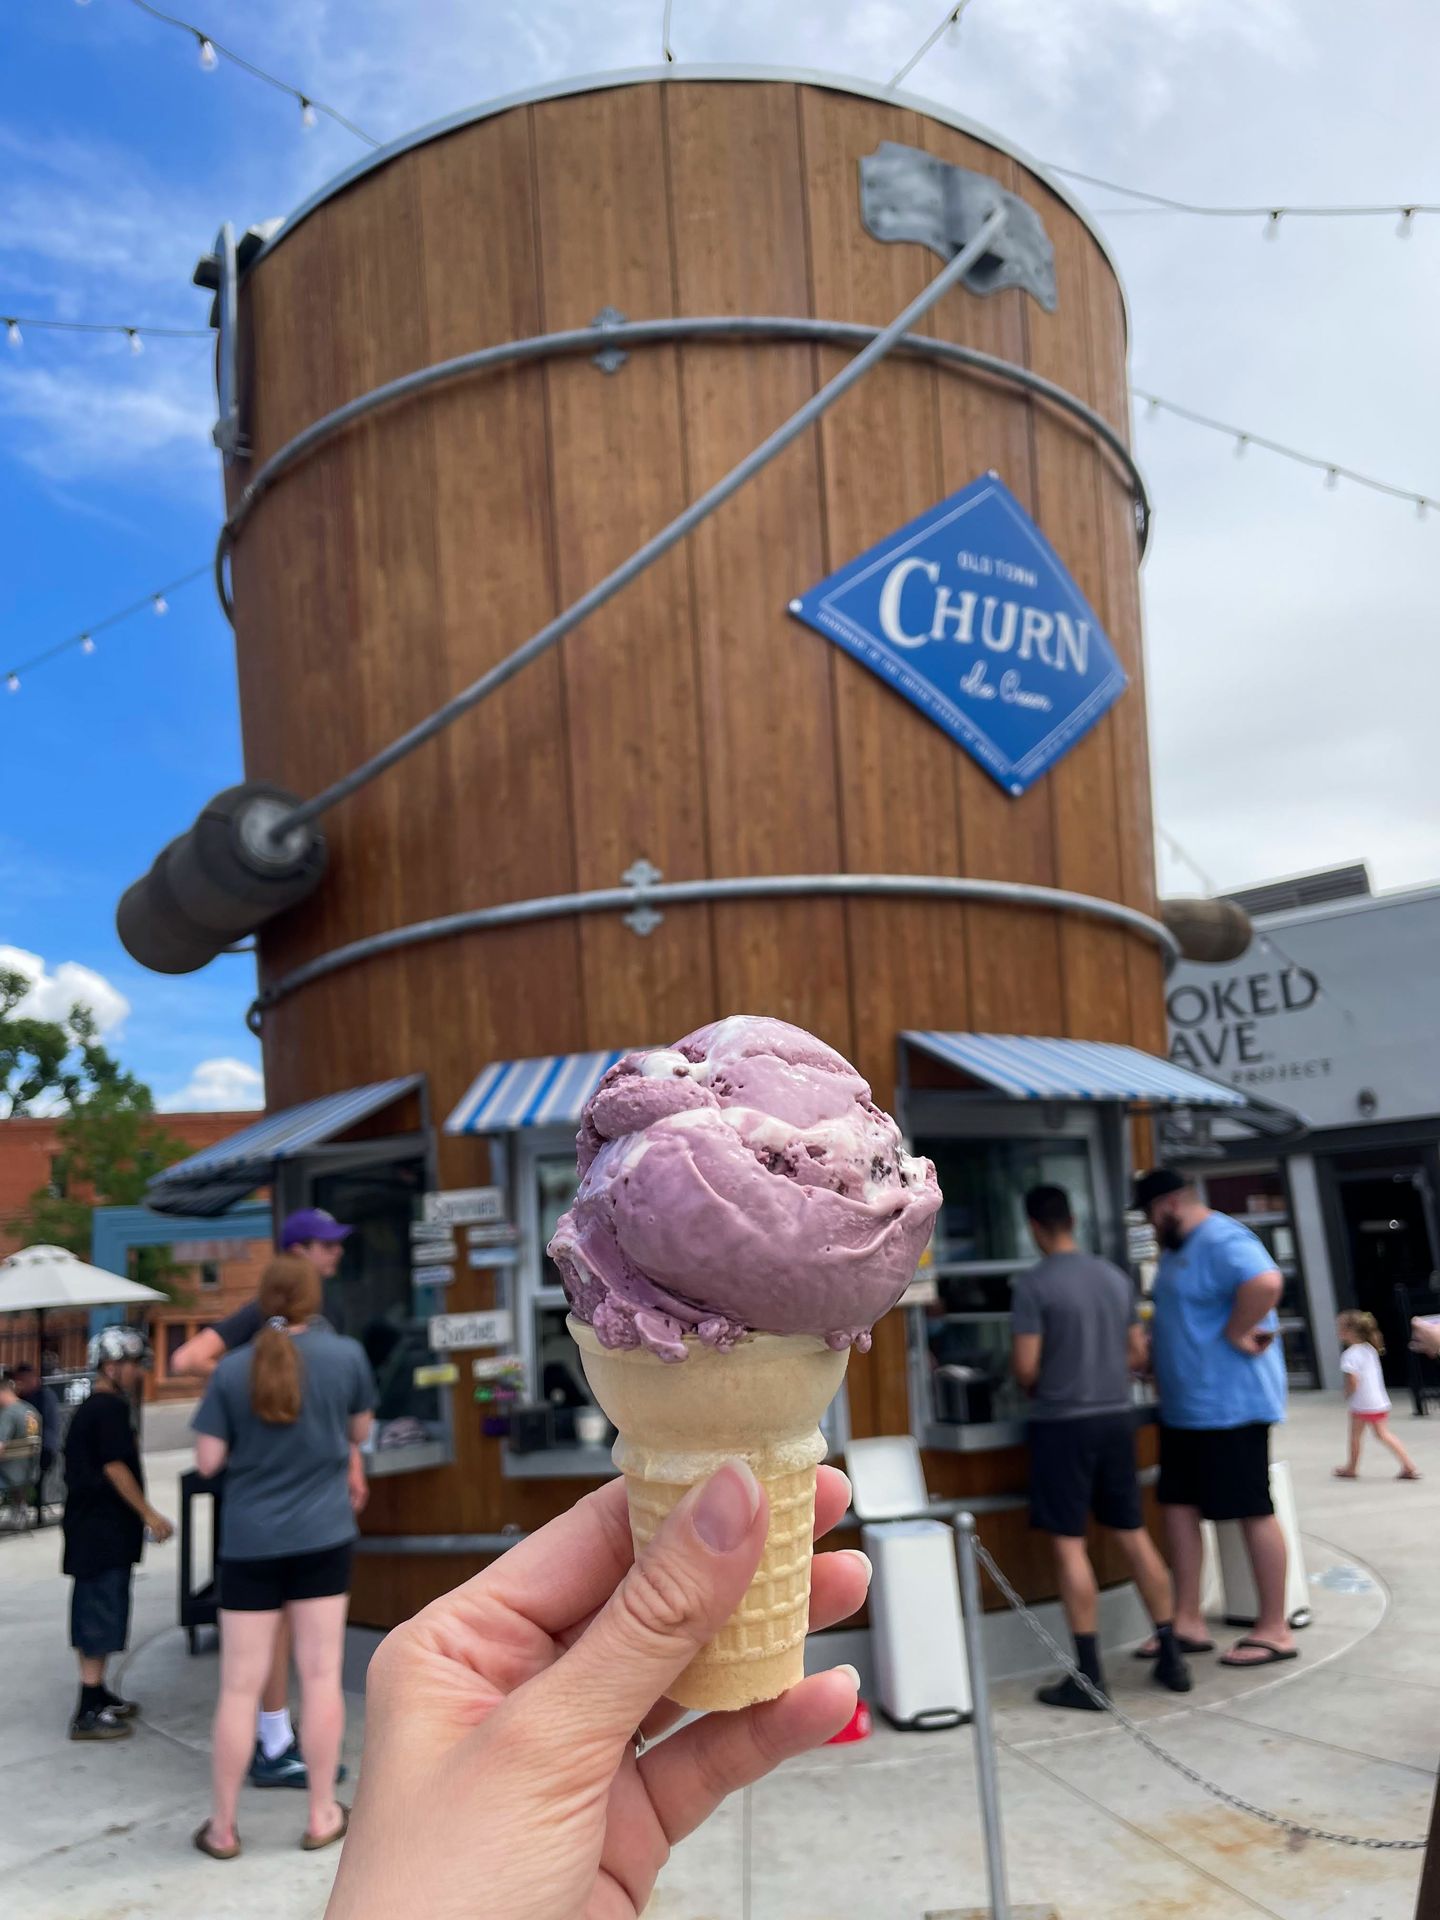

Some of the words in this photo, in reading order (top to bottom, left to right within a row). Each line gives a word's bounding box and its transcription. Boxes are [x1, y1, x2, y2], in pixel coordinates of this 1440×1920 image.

[956, 549, 992, 577] OLD
[995, 559, 1038, 588] TOWN
[878, 555, 1093, 677] CHURN
[1167, 966, 1320, 1029] OKED
[1168, 1021, 1265, 1070] AVE
[1231, 1057, 1333, 1086] PROJECT
